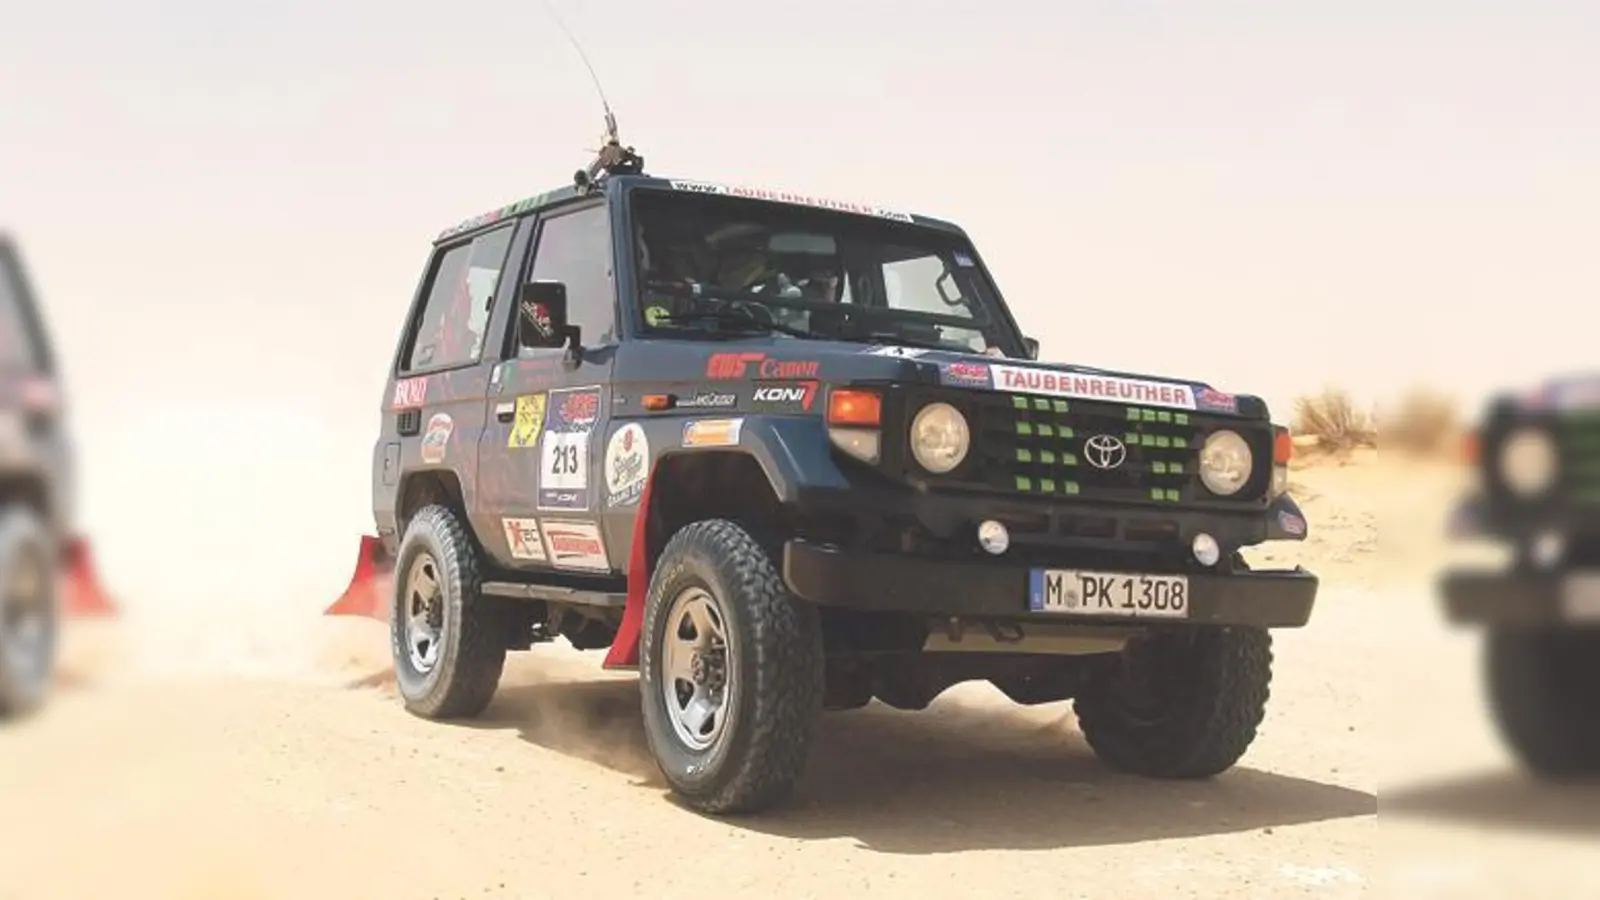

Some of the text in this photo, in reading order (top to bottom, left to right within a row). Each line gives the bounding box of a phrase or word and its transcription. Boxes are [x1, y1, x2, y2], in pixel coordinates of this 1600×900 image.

[760, 358, 820, 378] Canon
[753, 386, 806, 402] KONI
[1001, 369, 1188, 404] TAUBENREUTHER
[551, 444, 579, 475] 213
[1046, 574, 1184, 611] M PK 1308
